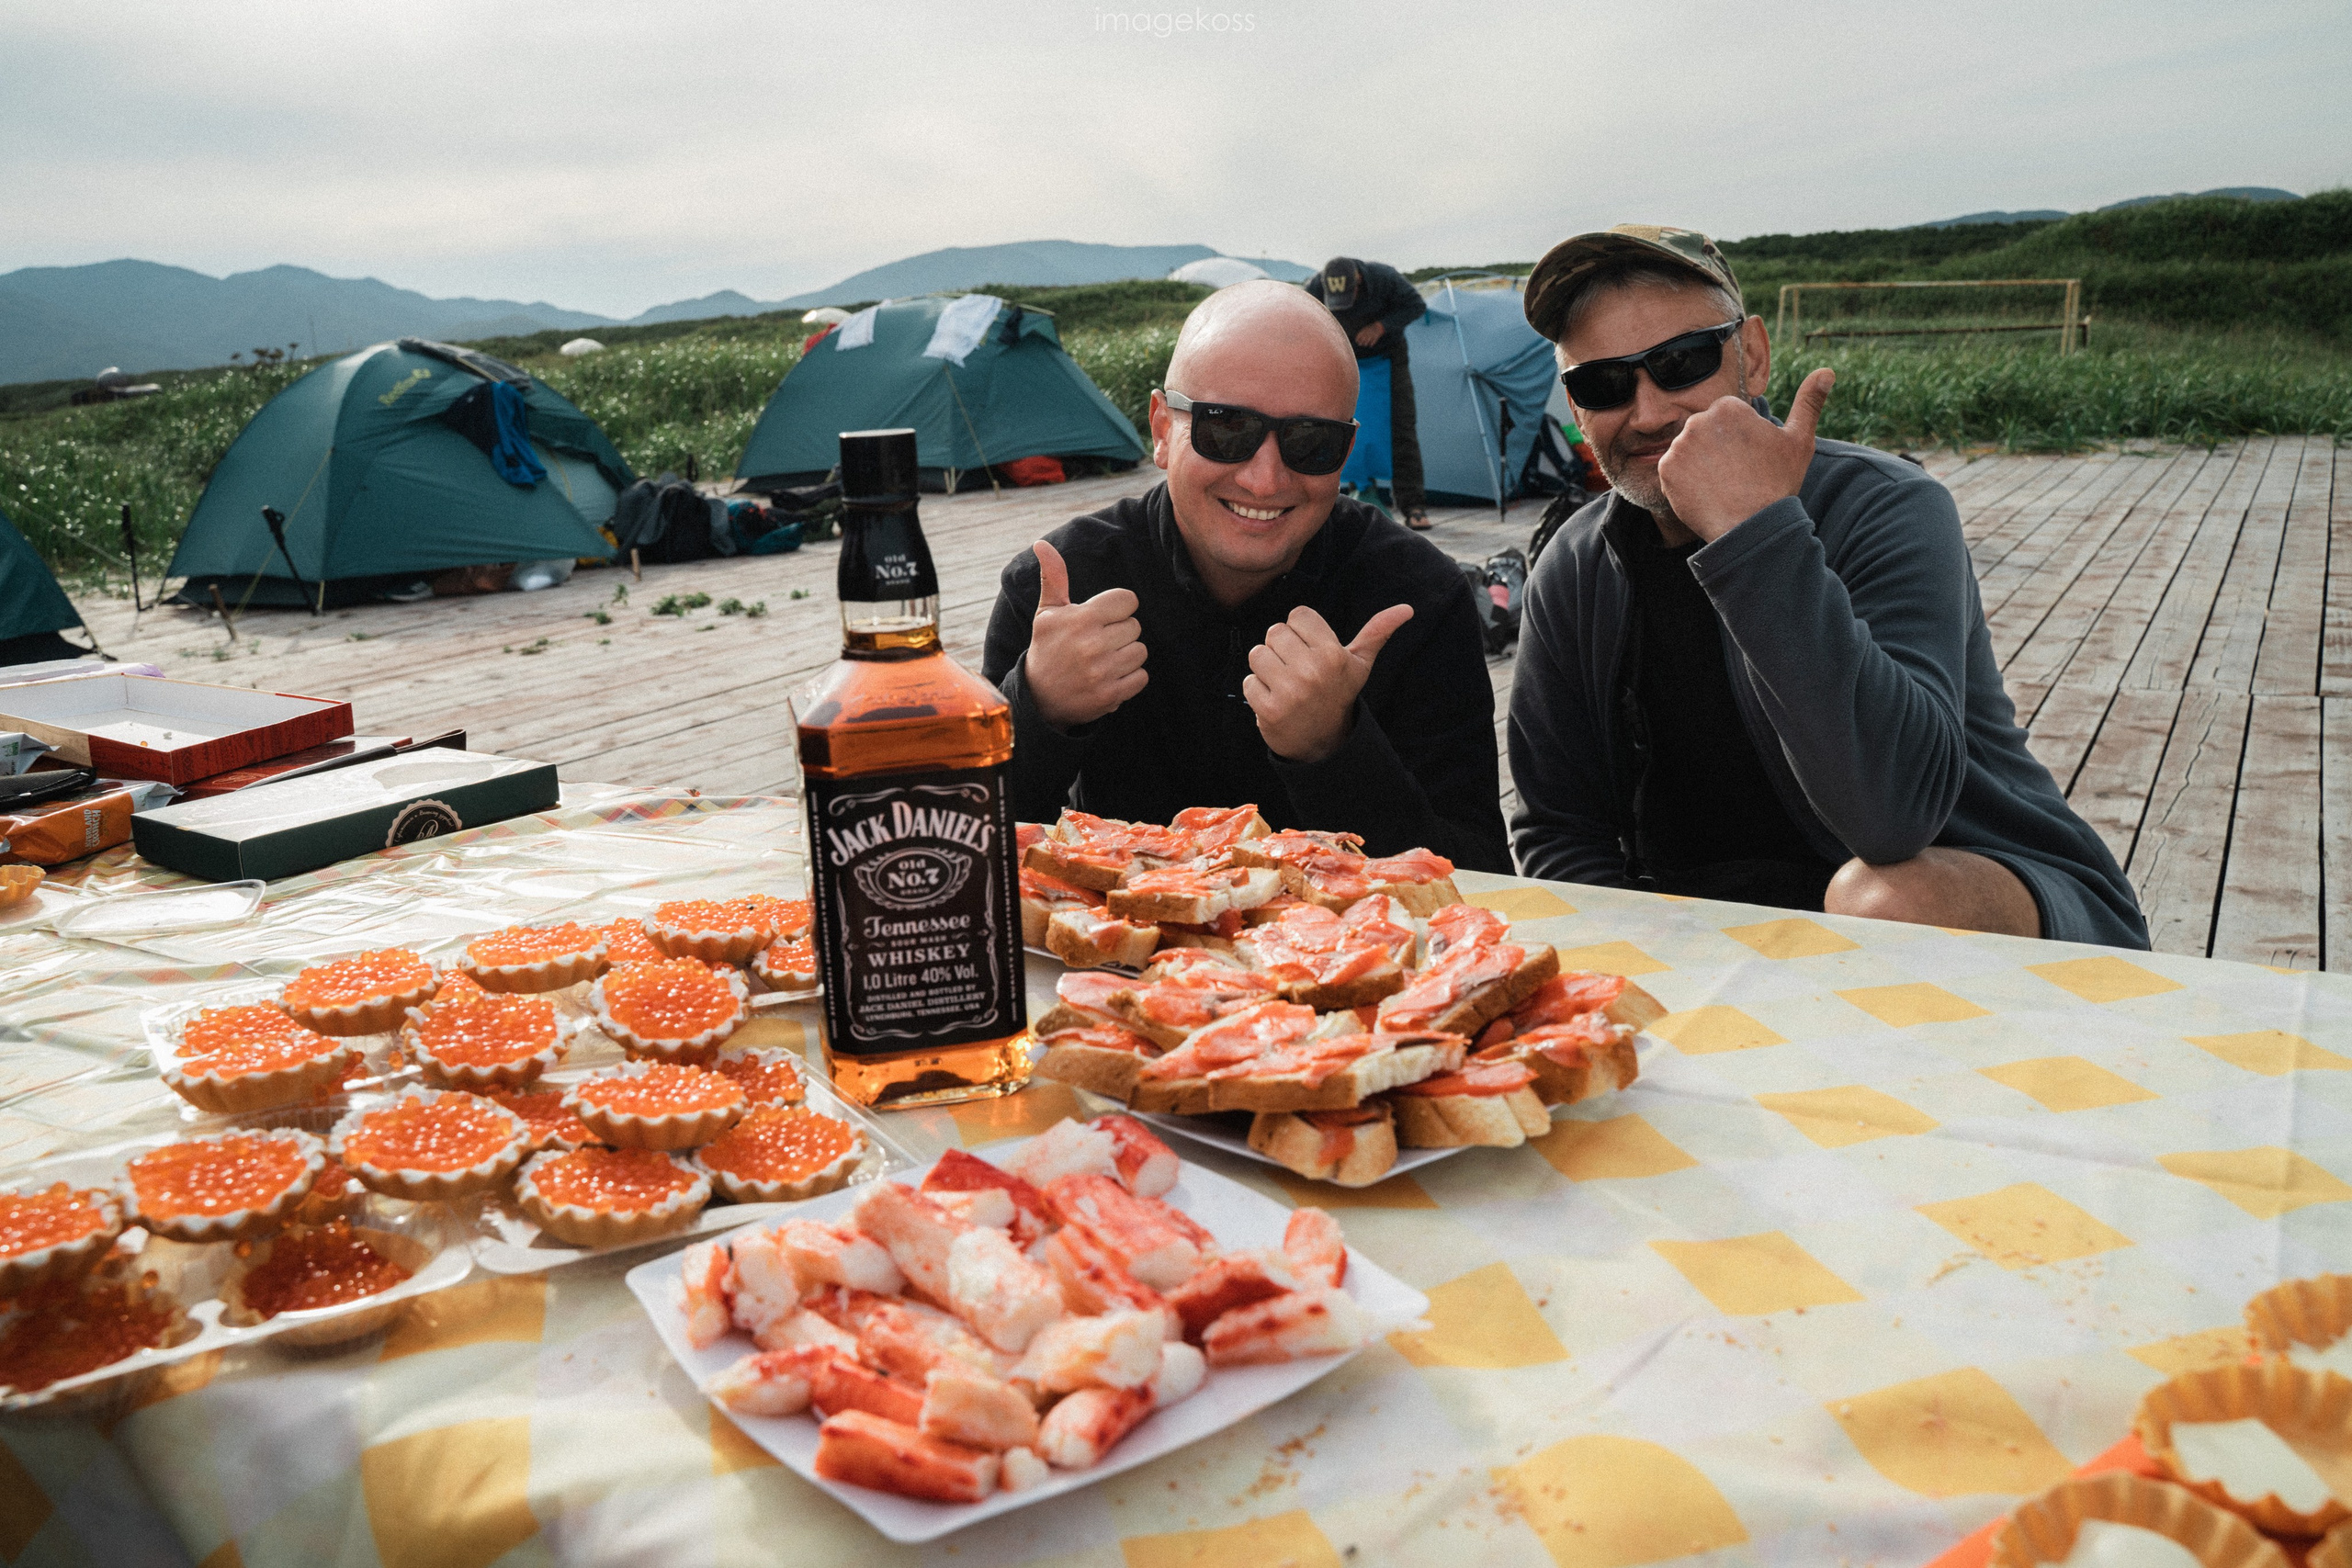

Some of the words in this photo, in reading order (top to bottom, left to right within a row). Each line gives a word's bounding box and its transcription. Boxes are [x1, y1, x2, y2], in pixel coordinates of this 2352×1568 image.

[1327, 276, 1346, 293] W
[875, 561, 919, 579] No.7
[92, 809, 101, 847] CRUNCH
[827, 813, 893, 866] JACK
[888, 867, 940, 889] No.7
[864, 914, 971, 938] Tennessee
[867, 942, 970, 967] WHISKEY
[884, 971, 917, 988] Litre
[921, 966, 952, 984] 40%
[954, 963, 979, 980] Vol.
[859, 1003, 885, 1013] JACK
[927, 991, 986, 1006] DISTILLERY
[866, 992, 908, 1003] DISTILLED
[910, 990, 926, 998] AND
[928, 986, 964, 997] BOTTLED
